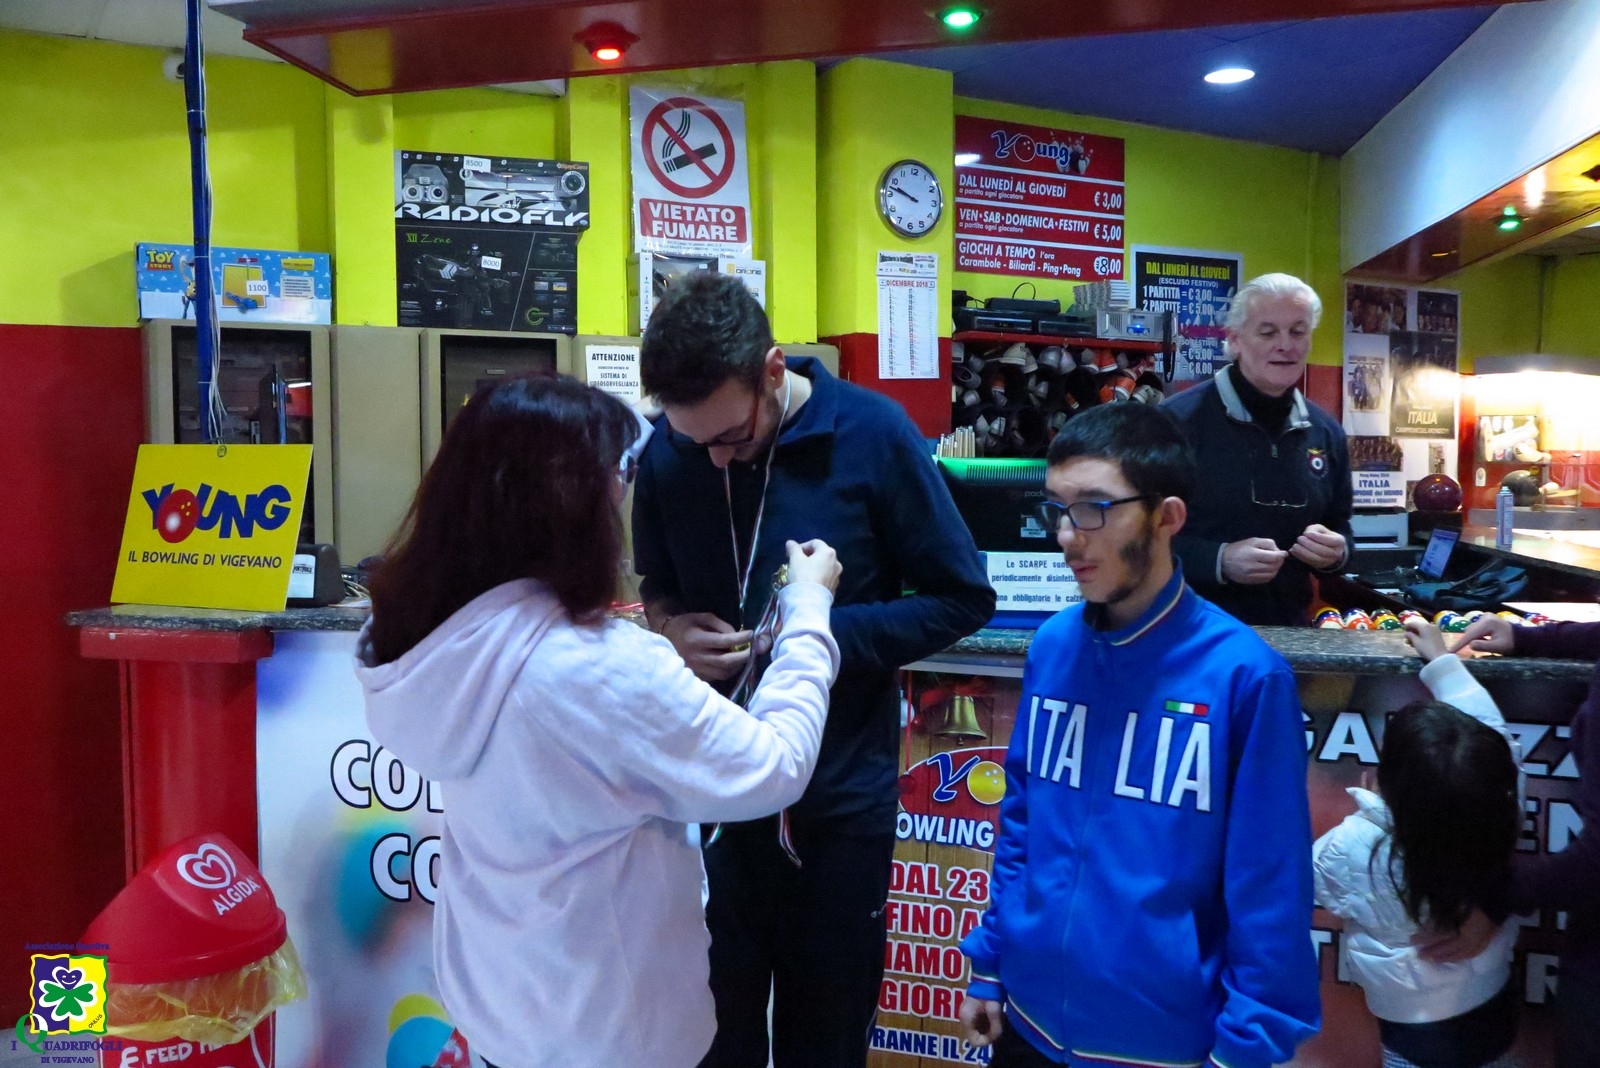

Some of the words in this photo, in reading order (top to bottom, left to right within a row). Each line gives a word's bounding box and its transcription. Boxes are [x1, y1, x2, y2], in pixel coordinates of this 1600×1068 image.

[466, 160, 483, 168] 8500
[911, 168, 919, 176] 12
[892, 177, 899, 185] 10
[959, 174, 977, 187] DAL
[981, 176, 1013, 191] LUNEDÌ
[1015, 181, 1026, 193] AL
[1029, 183, 1066, 198] GIOVEDÌ
[998, 192, 1024, 200] giocatore
[1094, 191, 1101, 206] €
[1102, 192, 1122, 210] 3,00
[395, 203, 589, 226] RADIOFLY
[649, 202, 736, 224] VIETATO
[897, 216, 902, 224] 7
[652, 220, 738, 241] FUMARE
[907, 222, 913, 230] 6
[985, 224, 997, 232] ogni
[998, 225, 1024, 233] giocatore
[1094, 223, 1100, 239] €
[1102, 224, 1121, 242] 5,00
[146, 250, 175, 263] TOY
[959, 241, 994, 256] GIOCHI
[995, 244, 1002, 256] A
[1005, 245, 1035, 259] TEMPO
[483, 258, 500, 267] 8000
[959, 256, 1001, 269] Carambole
[1009, 259, 1035, 271] Biliardi
[1146, 262, 1160, 274] DAL
[1162, 263, 1189, 277] LUNEDÌ
[1190, 265, 1199, 277] AL
[1143, 285, 1147, 297] 1
[1149, 286, 1180, 299] PARTITA
[1142, 300, 1148, 312] 2
[1150, 300, 1181, 314] PARTITE
[592, 353, 635, 361] ATTENZIONE
[1408, 411, 1437, 425] ITALIA
[1359, 480, 1390, 488] ITALIA
[141, 482, 292, 544] YOUNG
[128, 551, 137, 562] IL
[142, 551, 198, 565] BOWLING
[203, 553, 215, 565] DI
[221, 554, 282, 568] VIGEVANO
[1019, 560, 1047, 569] SCARPE
[991, 574, 1041, 583] periodicamente
[1013, 594, 1051, 603] obbligatorie
[1055, 594, 1061, 602] le
[889, 860, 943, 899] DAL
[946, 866, 990, 904] 23
[211, 876, 261, 916] ALGIDA
[886, 898, 954, 940] FINO
[145, 1042, 192, 1065] FEED
[941, 1034, 961, 1062] IL
